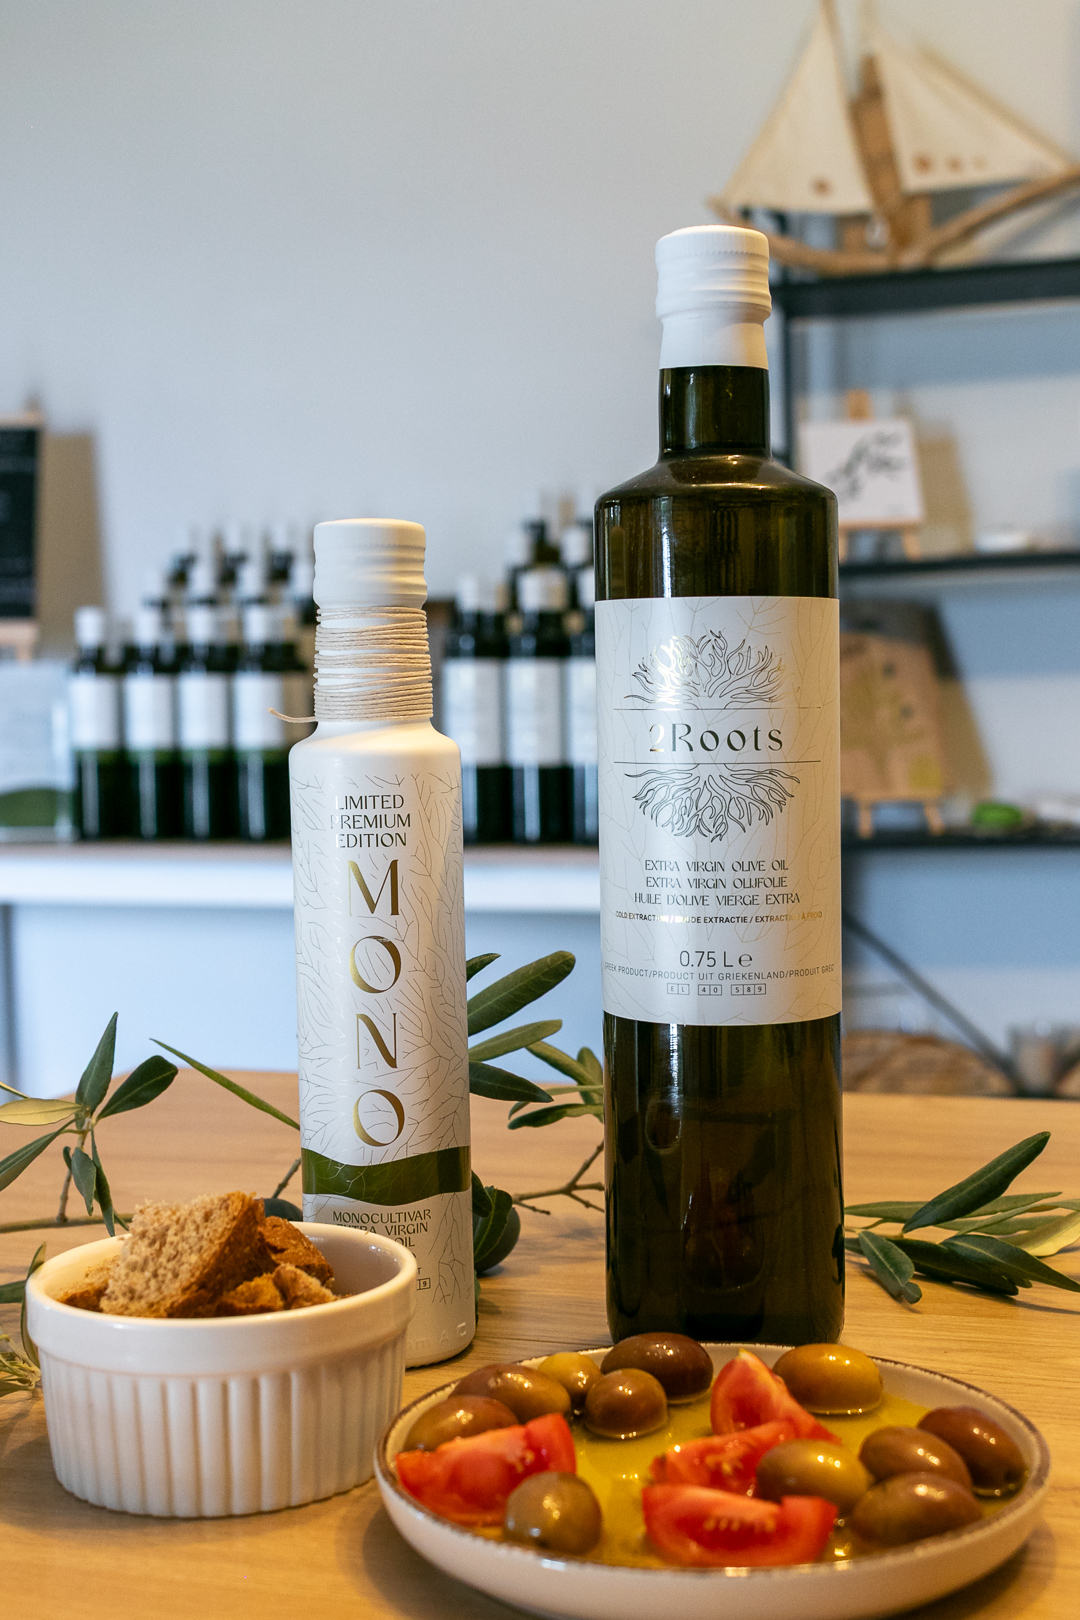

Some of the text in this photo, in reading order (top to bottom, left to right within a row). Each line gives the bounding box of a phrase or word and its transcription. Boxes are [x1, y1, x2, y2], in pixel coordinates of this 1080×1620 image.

[649, 723, 783, 752] 2Roots
[335, 795, 404, 810] LIMITED
[331, 813, 411, 829] PREMIUM
[336, 832, 407, 848] EDITION
[645, 859, 788, 873] EXTRA VIRGIN OLIVE OIL
[646, 876, 787, 889] EXTRA VIRGIN OLIJFOLIE
[634, 892, 800, 906] HUILE D'OLIVE VIERGE EXTRA
[704, 916, 748, 924] EXTRACTIE
[679, 950, 717, 968] 0.75
[723, 951, 734, 968] L
[698, 972, 715, 981] UIT
[348, 859, 405, 1147] MONO
[332, 1209, 432, 1224] MONOCULTIVAR
[385, 1222, 428, 1236] VIRGIN
